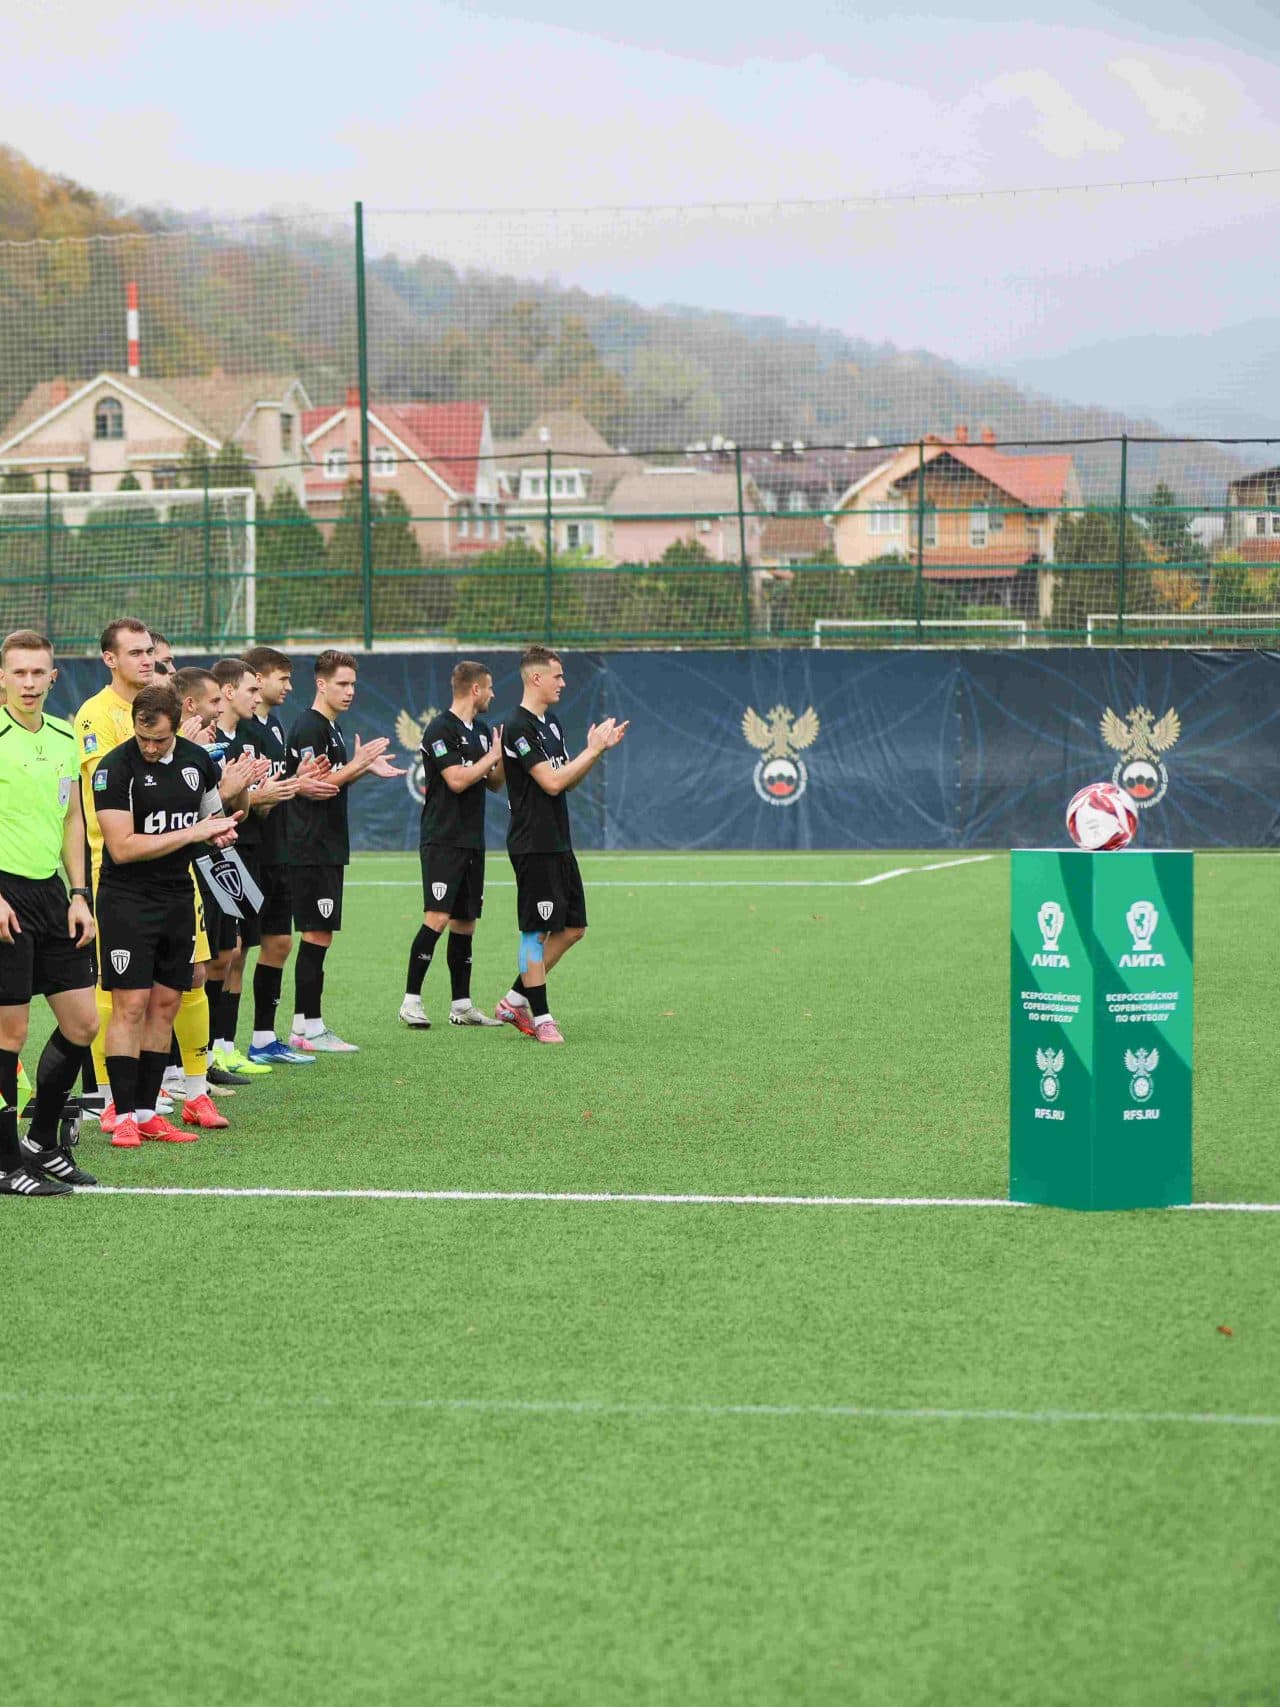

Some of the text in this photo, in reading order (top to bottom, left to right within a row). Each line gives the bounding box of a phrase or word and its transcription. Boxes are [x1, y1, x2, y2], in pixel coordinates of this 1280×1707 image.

[1031, 953, 1070, 968] ЛИГА
[1119, 953, 1166, 967] ЛИГА
[1021, 991, 1081, 1002] ВСЕРОССИЙСКОЕ
[1106, 991, 1178, 1001] ВСЕРОССИЙСКОЕ
[1023, 1002, 1079, 1013] СОРЕВНОВАНИЕ
[1108, 1003, 1176, 1012] СОРЕВНОВАНИЕ
[1028, 1012, 1073, 1023] ПО ФУТБОЛУ
[1115, 1013, 1169, 1023] ПО ФУТБОЛУ
[1035, 1108, 1065, 1121] RFS.RU
[1123, 1109, 1160, 1121] RFS.RU
